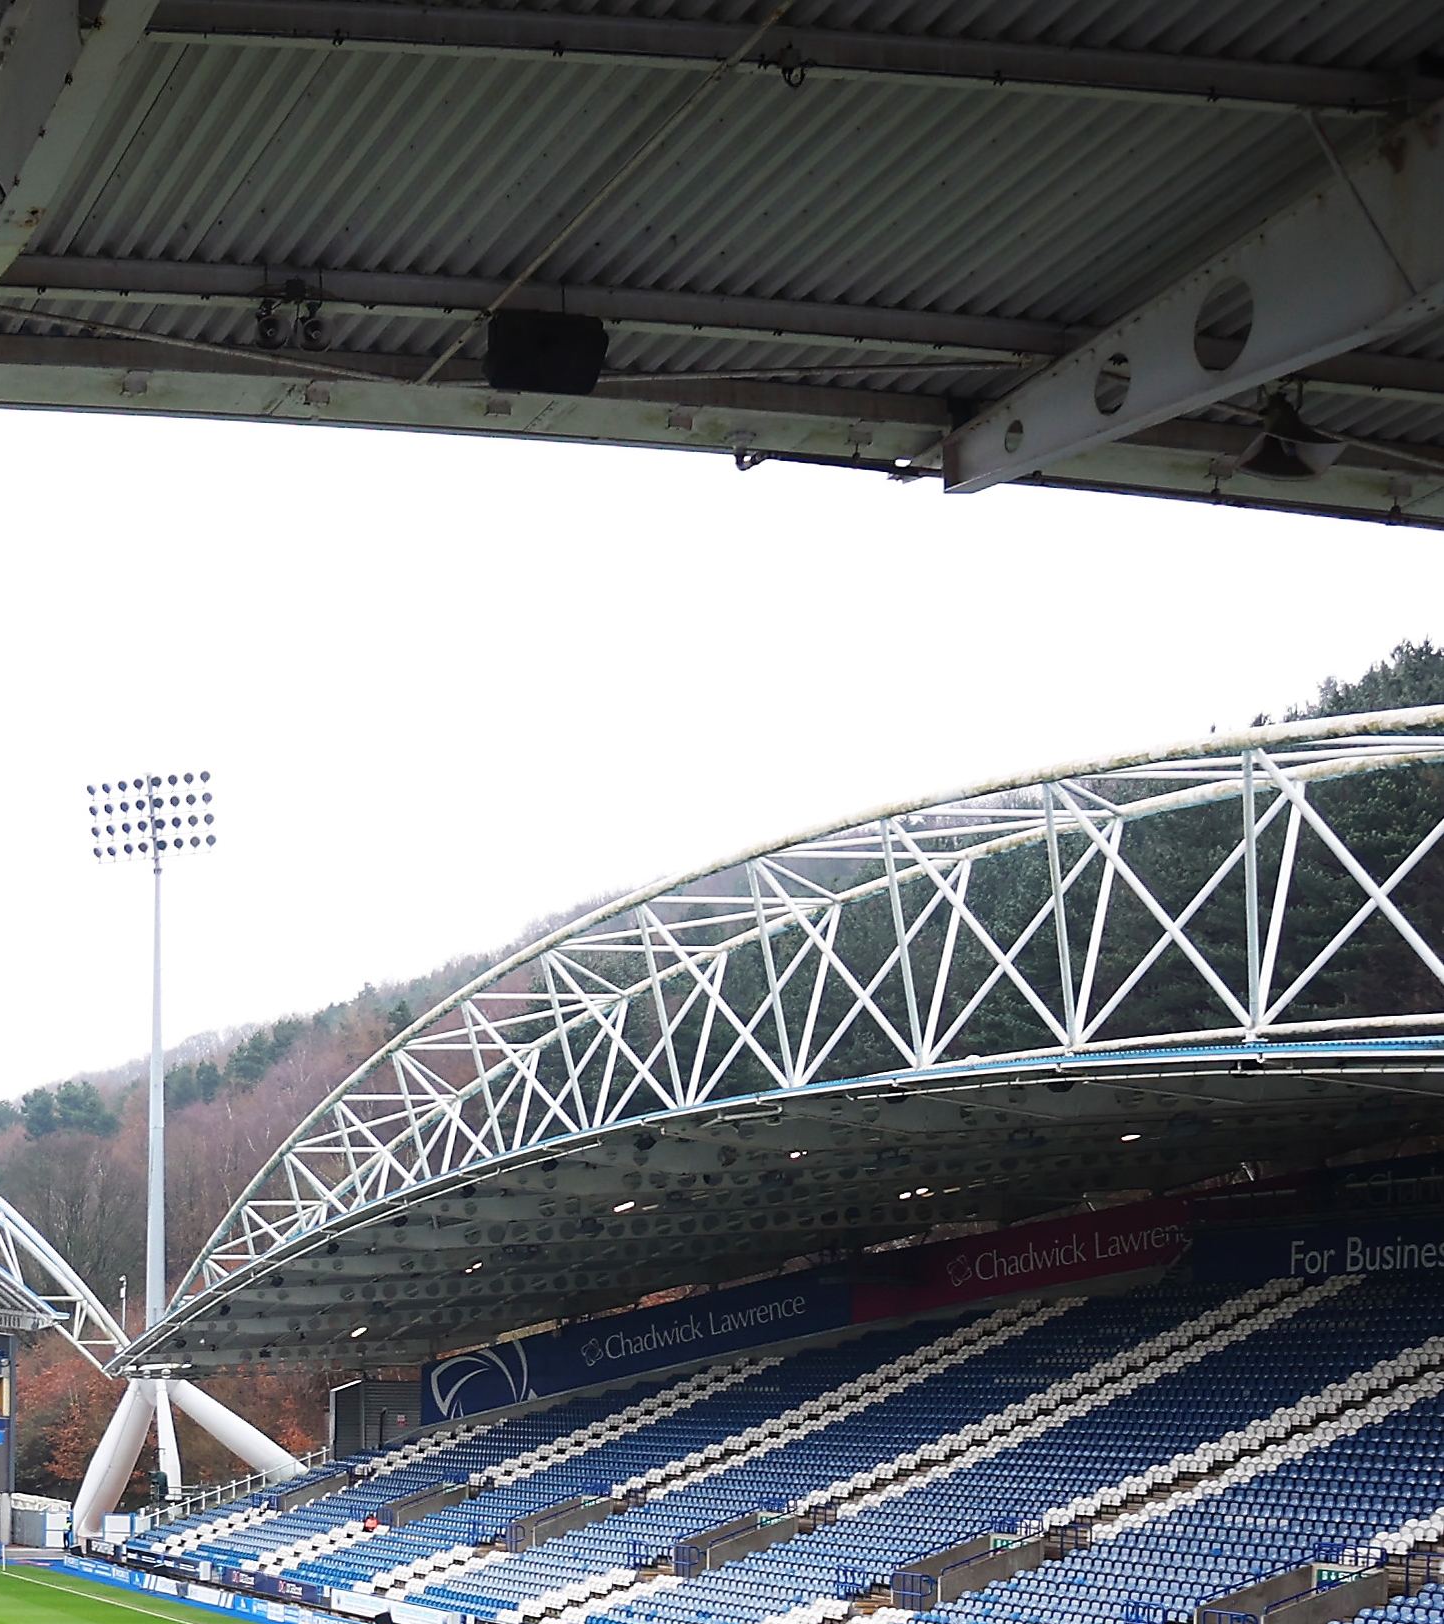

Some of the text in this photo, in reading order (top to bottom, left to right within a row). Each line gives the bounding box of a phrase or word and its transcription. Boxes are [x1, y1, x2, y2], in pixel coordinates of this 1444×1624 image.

[975, 1234, 1086, 1281] Chadwick
[1291, 1240, 1336, 1275] For
[605, 1294, 806, 1361] Chadwick Lawrence
